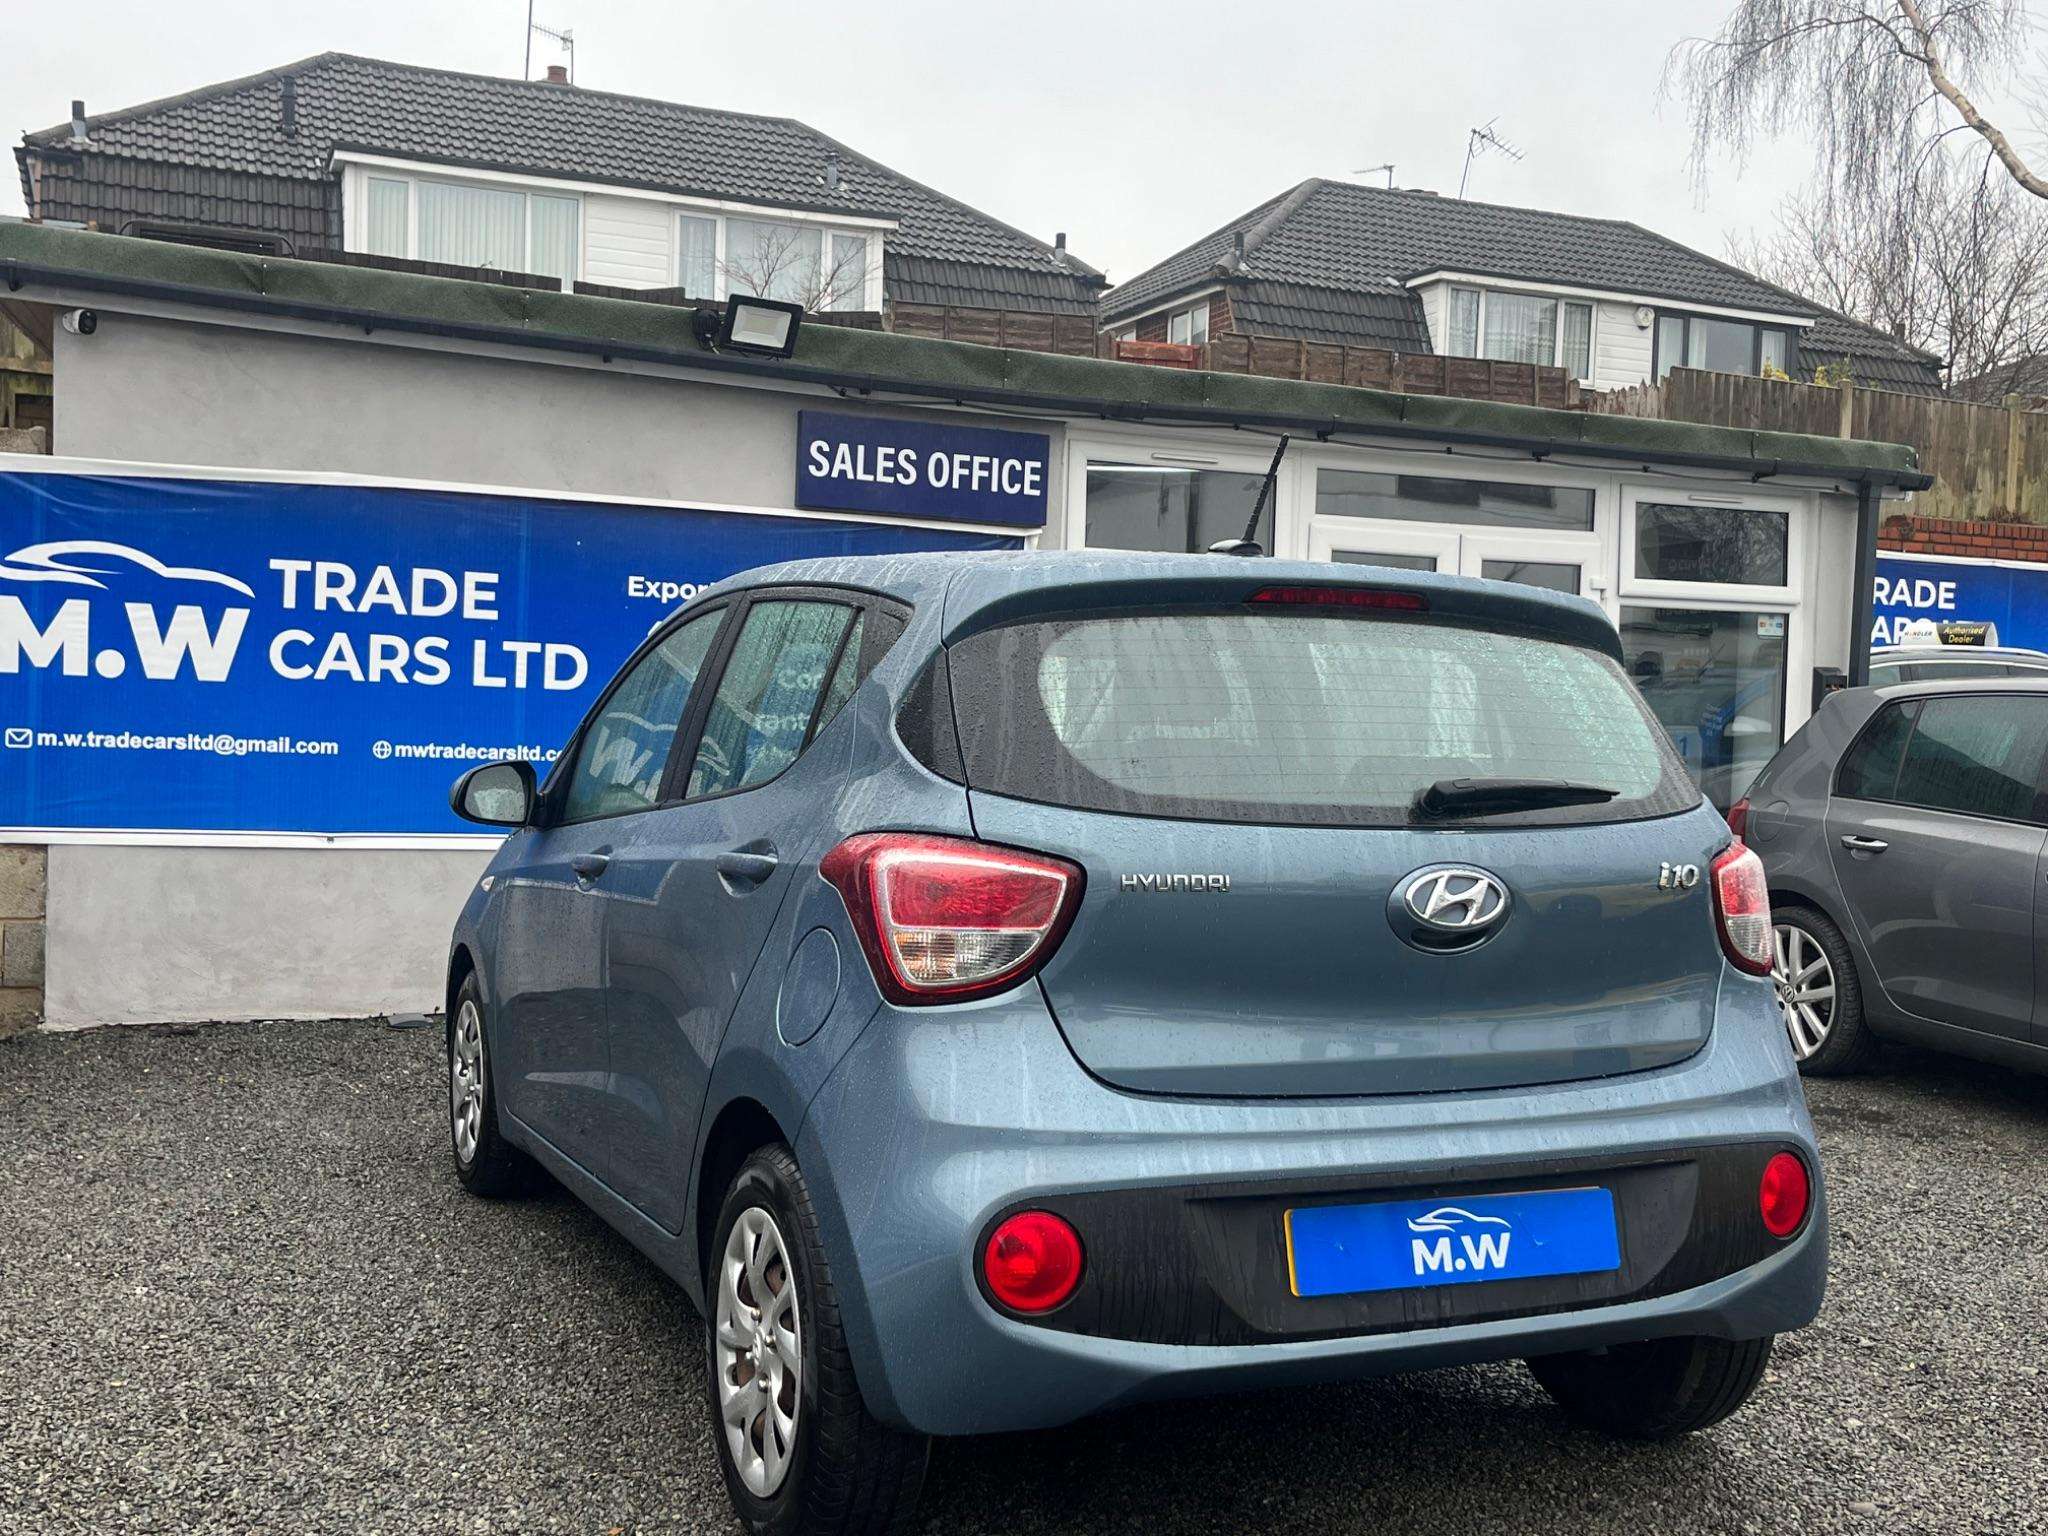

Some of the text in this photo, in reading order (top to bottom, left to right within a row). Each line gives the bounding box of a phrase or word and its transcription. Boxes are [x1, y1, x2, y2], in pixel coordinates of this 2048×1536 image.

[807, 439, 1042, 497] SALES OFFICE
[269, 558, 500, 621] TRADE
[628, 575, 714, 603] Expor
[1873, 576, 1957, 610] RADE
[0, 595, 251, 683] M.W
[1948, 633, 1975, 644] Dealer
[268, 629, 589, 691] CARS LTD
[37, 729, 339, 757] m.w.tradecarsltd@gmail.com
[1120, 872, 1231, 894] HYUNDAI
[1660, 861, 1699, 891] i10
[1412, 1231, 1512, 1276] M.W
